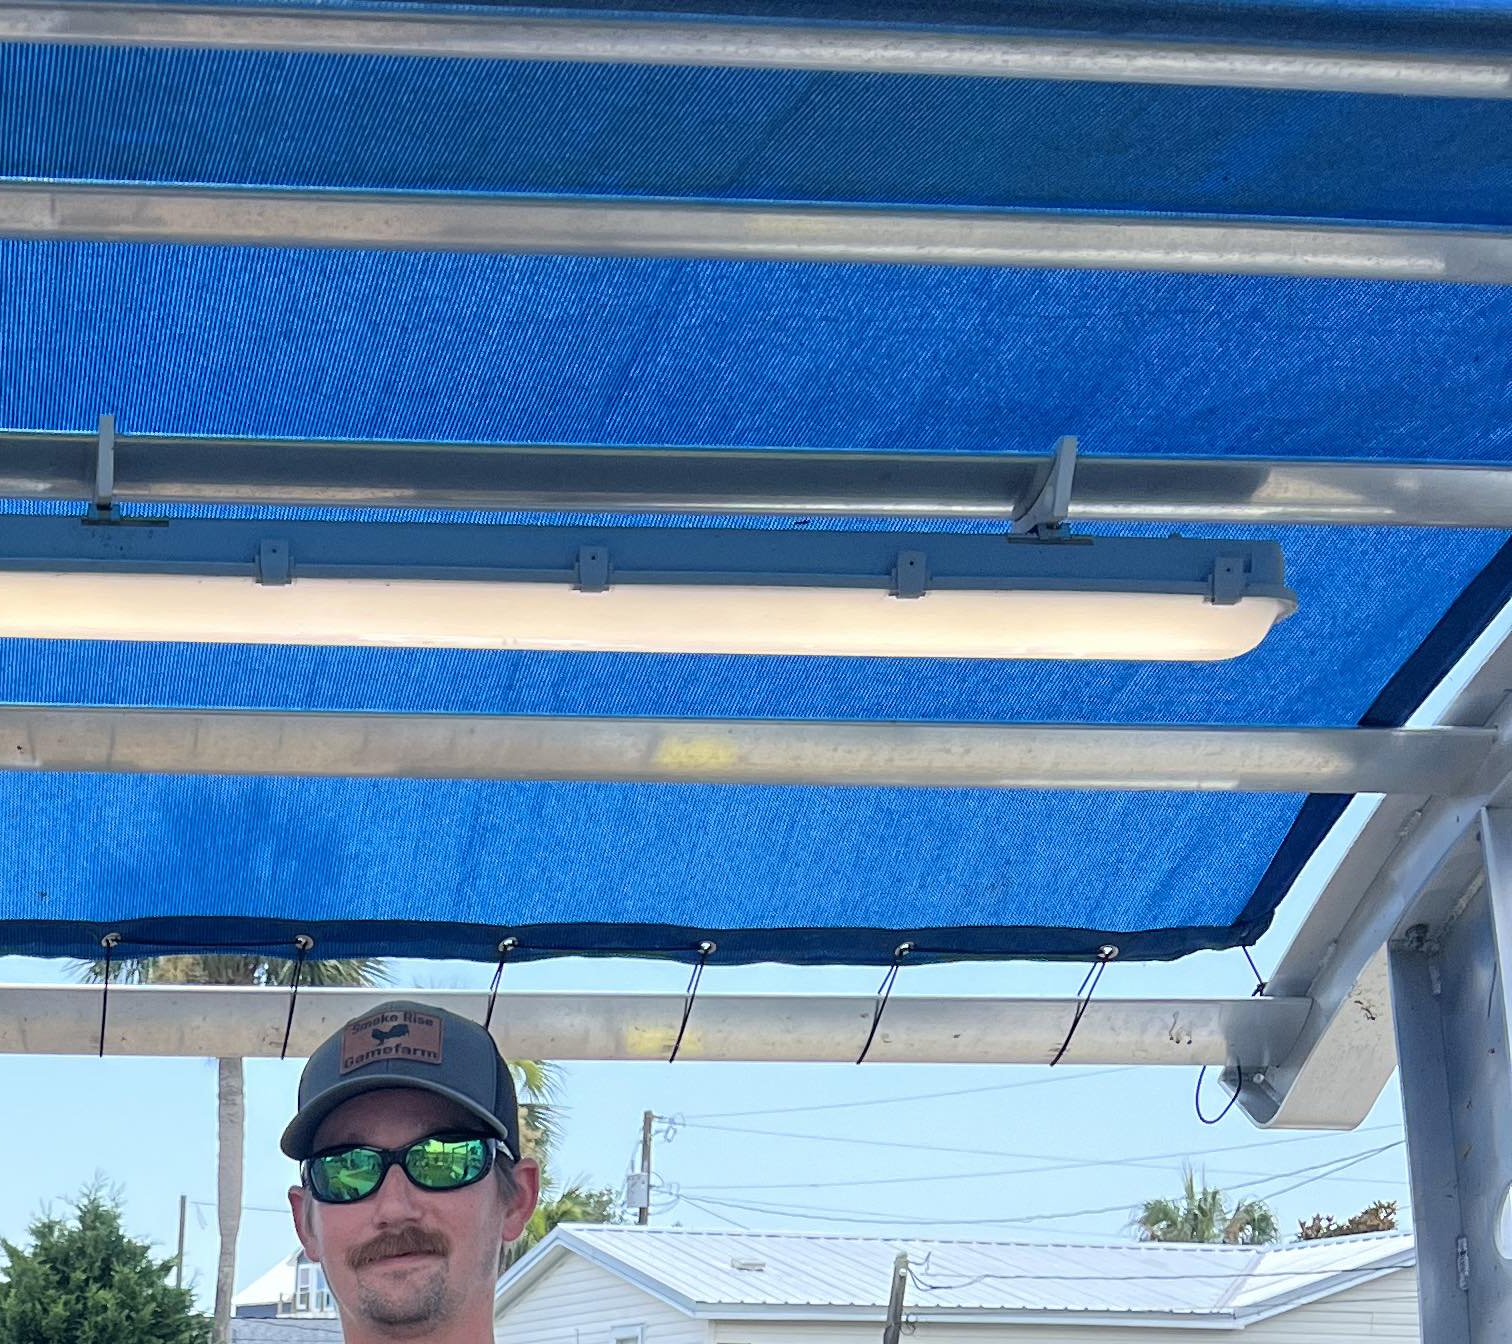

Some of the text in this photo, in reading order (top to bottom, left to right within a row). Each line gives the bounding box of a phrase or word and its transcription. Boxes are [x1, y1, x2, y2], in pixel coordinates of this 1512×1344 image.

[351, 1009, 434, 1036] Smoke Rise
[344, 1043, 438, 1068] Gamefarm
